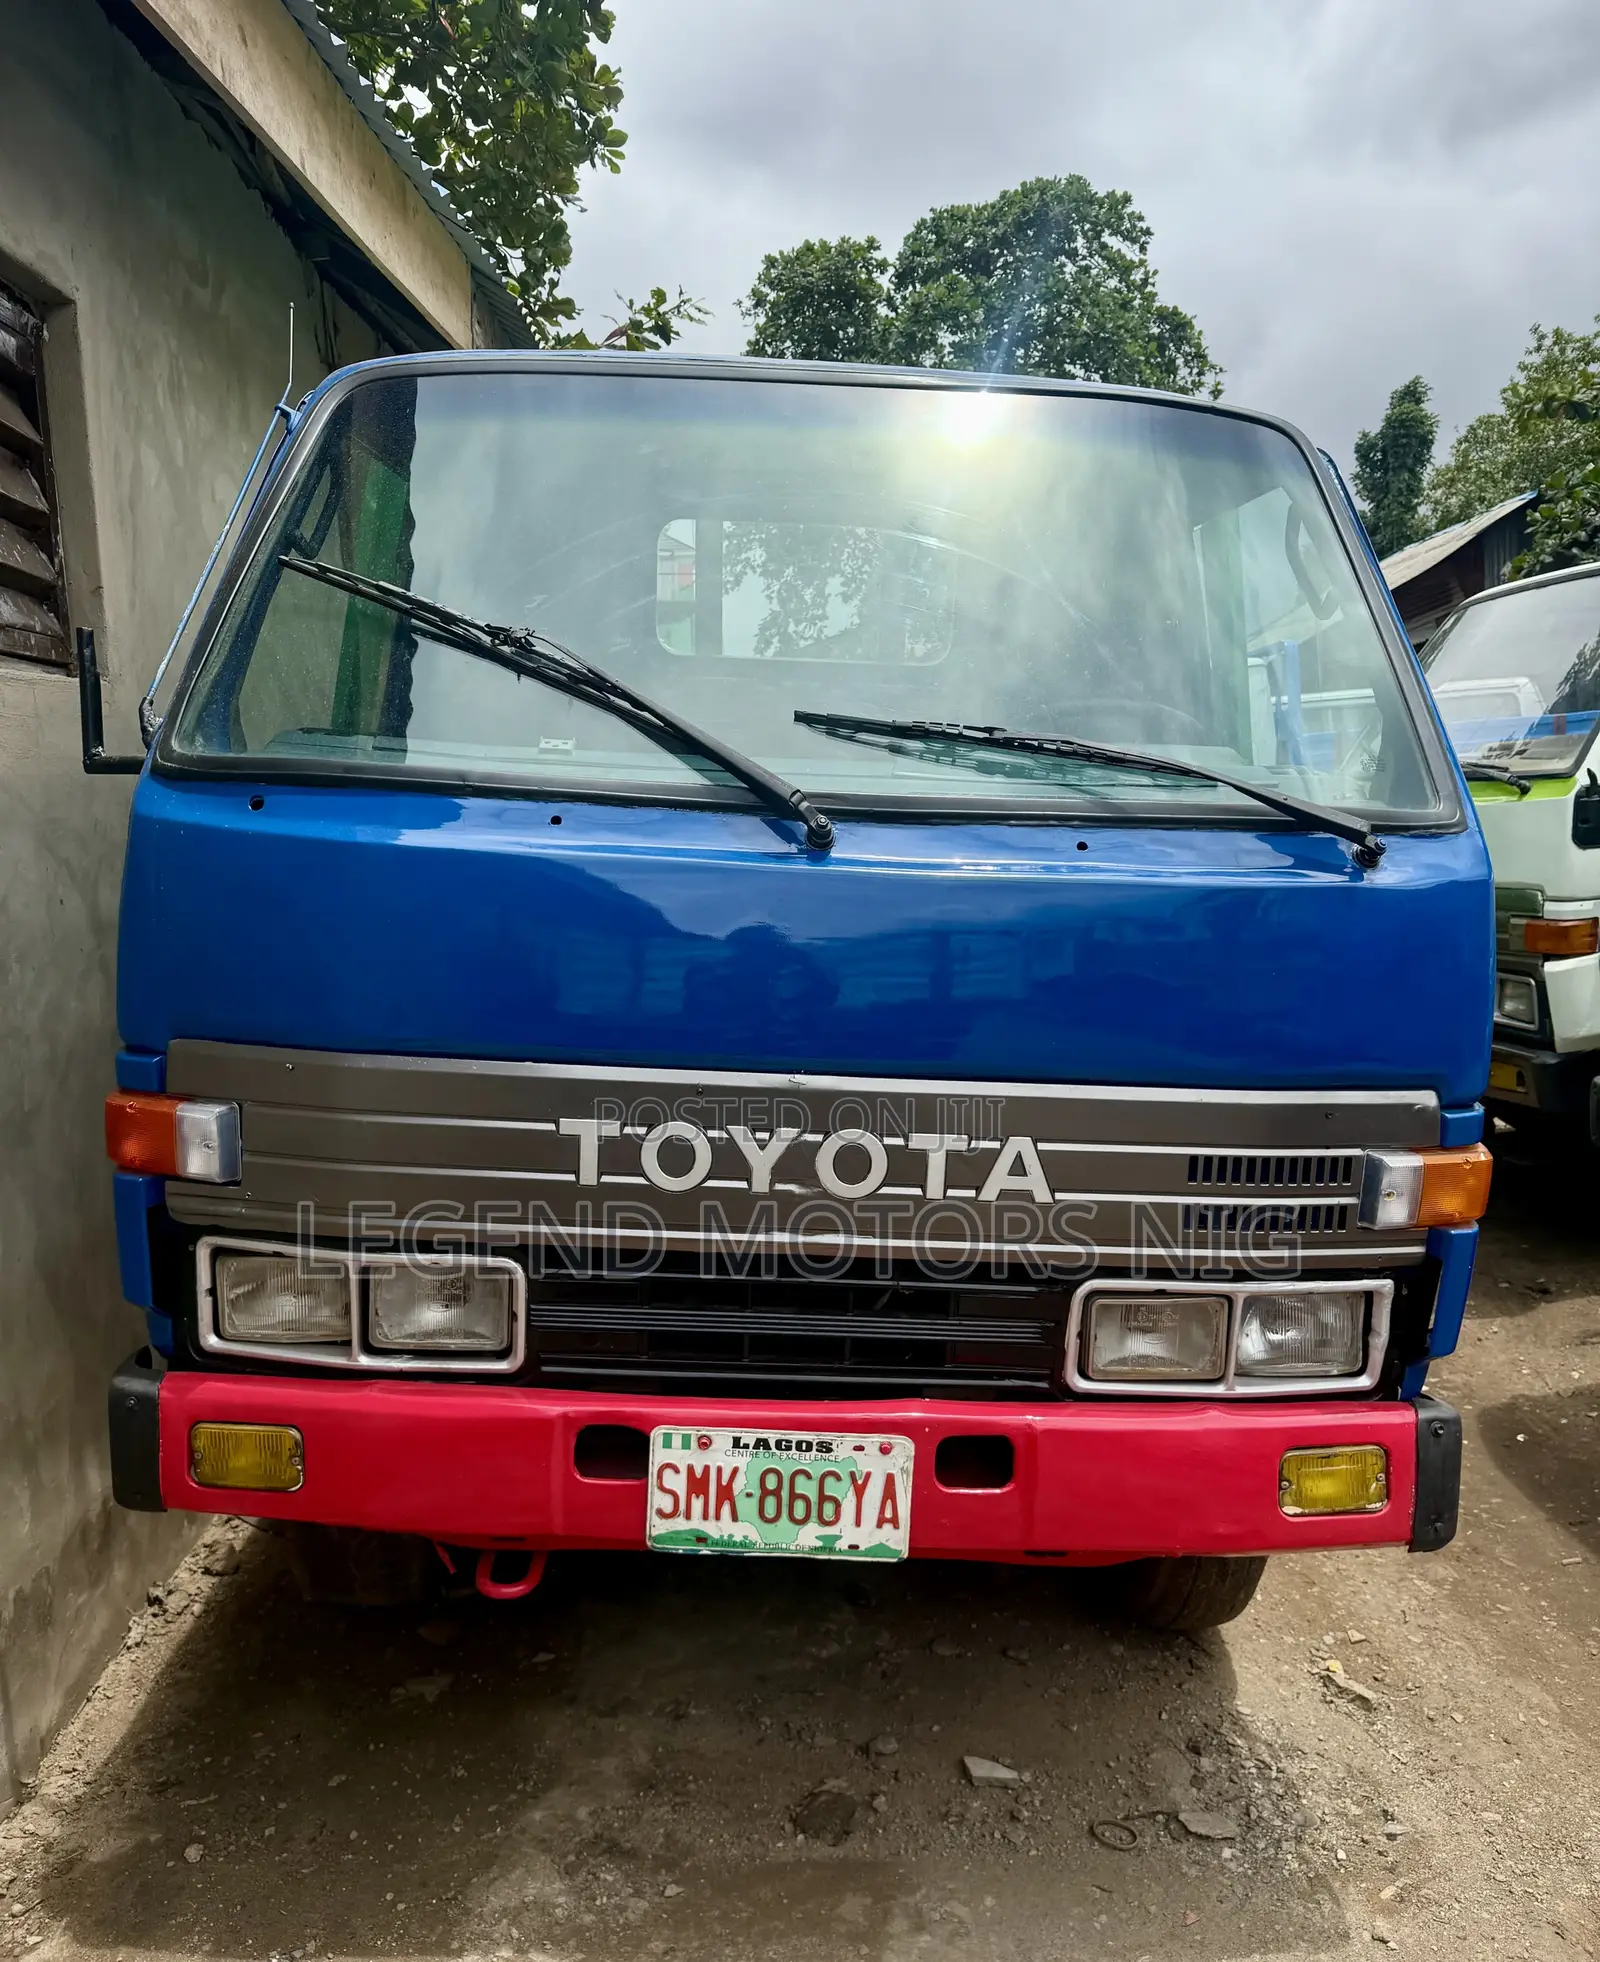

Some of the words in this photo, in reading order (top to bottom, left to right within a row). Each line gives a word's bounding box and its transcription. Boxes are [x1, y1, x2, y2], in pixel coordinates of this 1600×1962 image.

[557, 1117, 1055, 1205] TOYOTA
[731, 1436, 834, 1454] LAGOS
[724, 1449, 761, 1459] CENTRE
[763, 1451, 777, 1459] OF
[779, 1452, 840, 1464] EXCELLENCE
